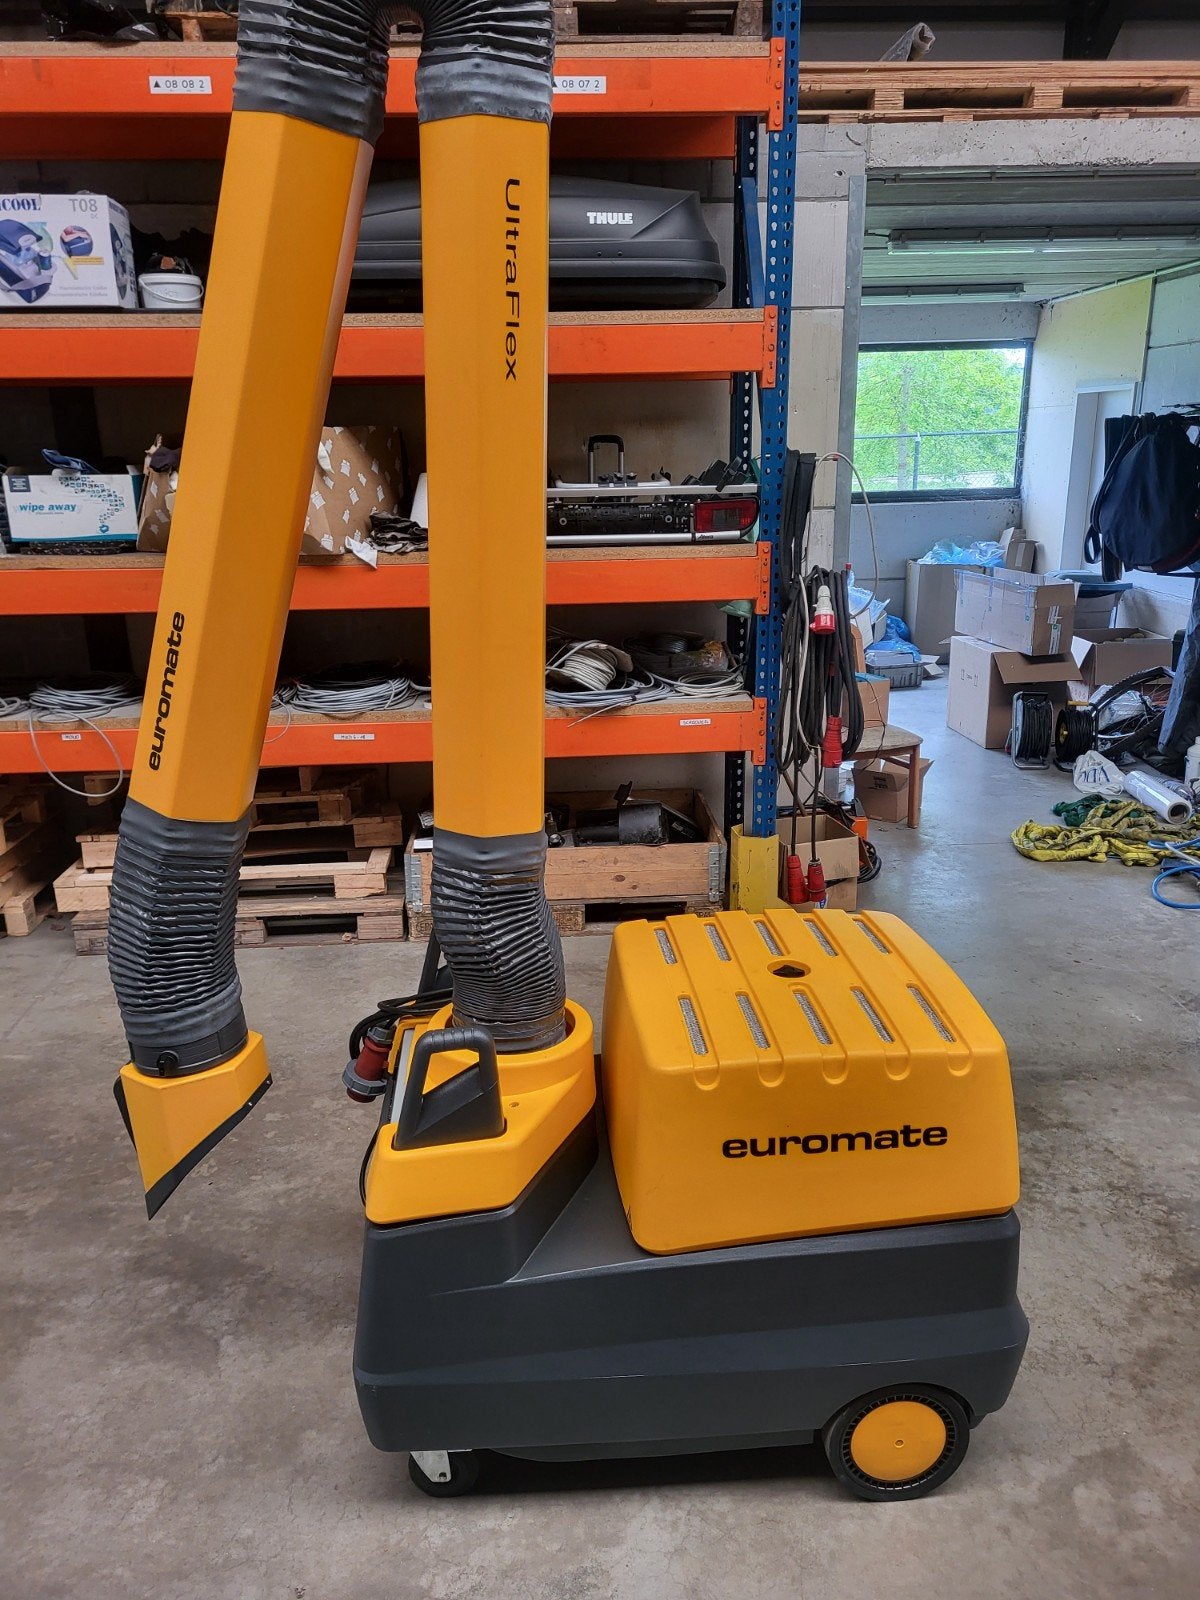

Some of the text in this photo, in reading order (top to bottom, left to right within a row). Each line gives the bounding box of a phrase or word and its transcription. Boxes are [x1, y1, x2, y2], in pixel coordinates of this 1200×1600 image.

[165, 79, 205, 89] 08 08 2
[561, 79, 600, 89] 08 07 2
[68, 198, 98, 212] T08
[586, 211, 634, 225] THULE
[505, 178, 521, 382] UltraFlex
[19, 502, 77, 513] wipe away
[148, 611, 185, 771] euromate
[721, 1124, 948, 1159] euromate
